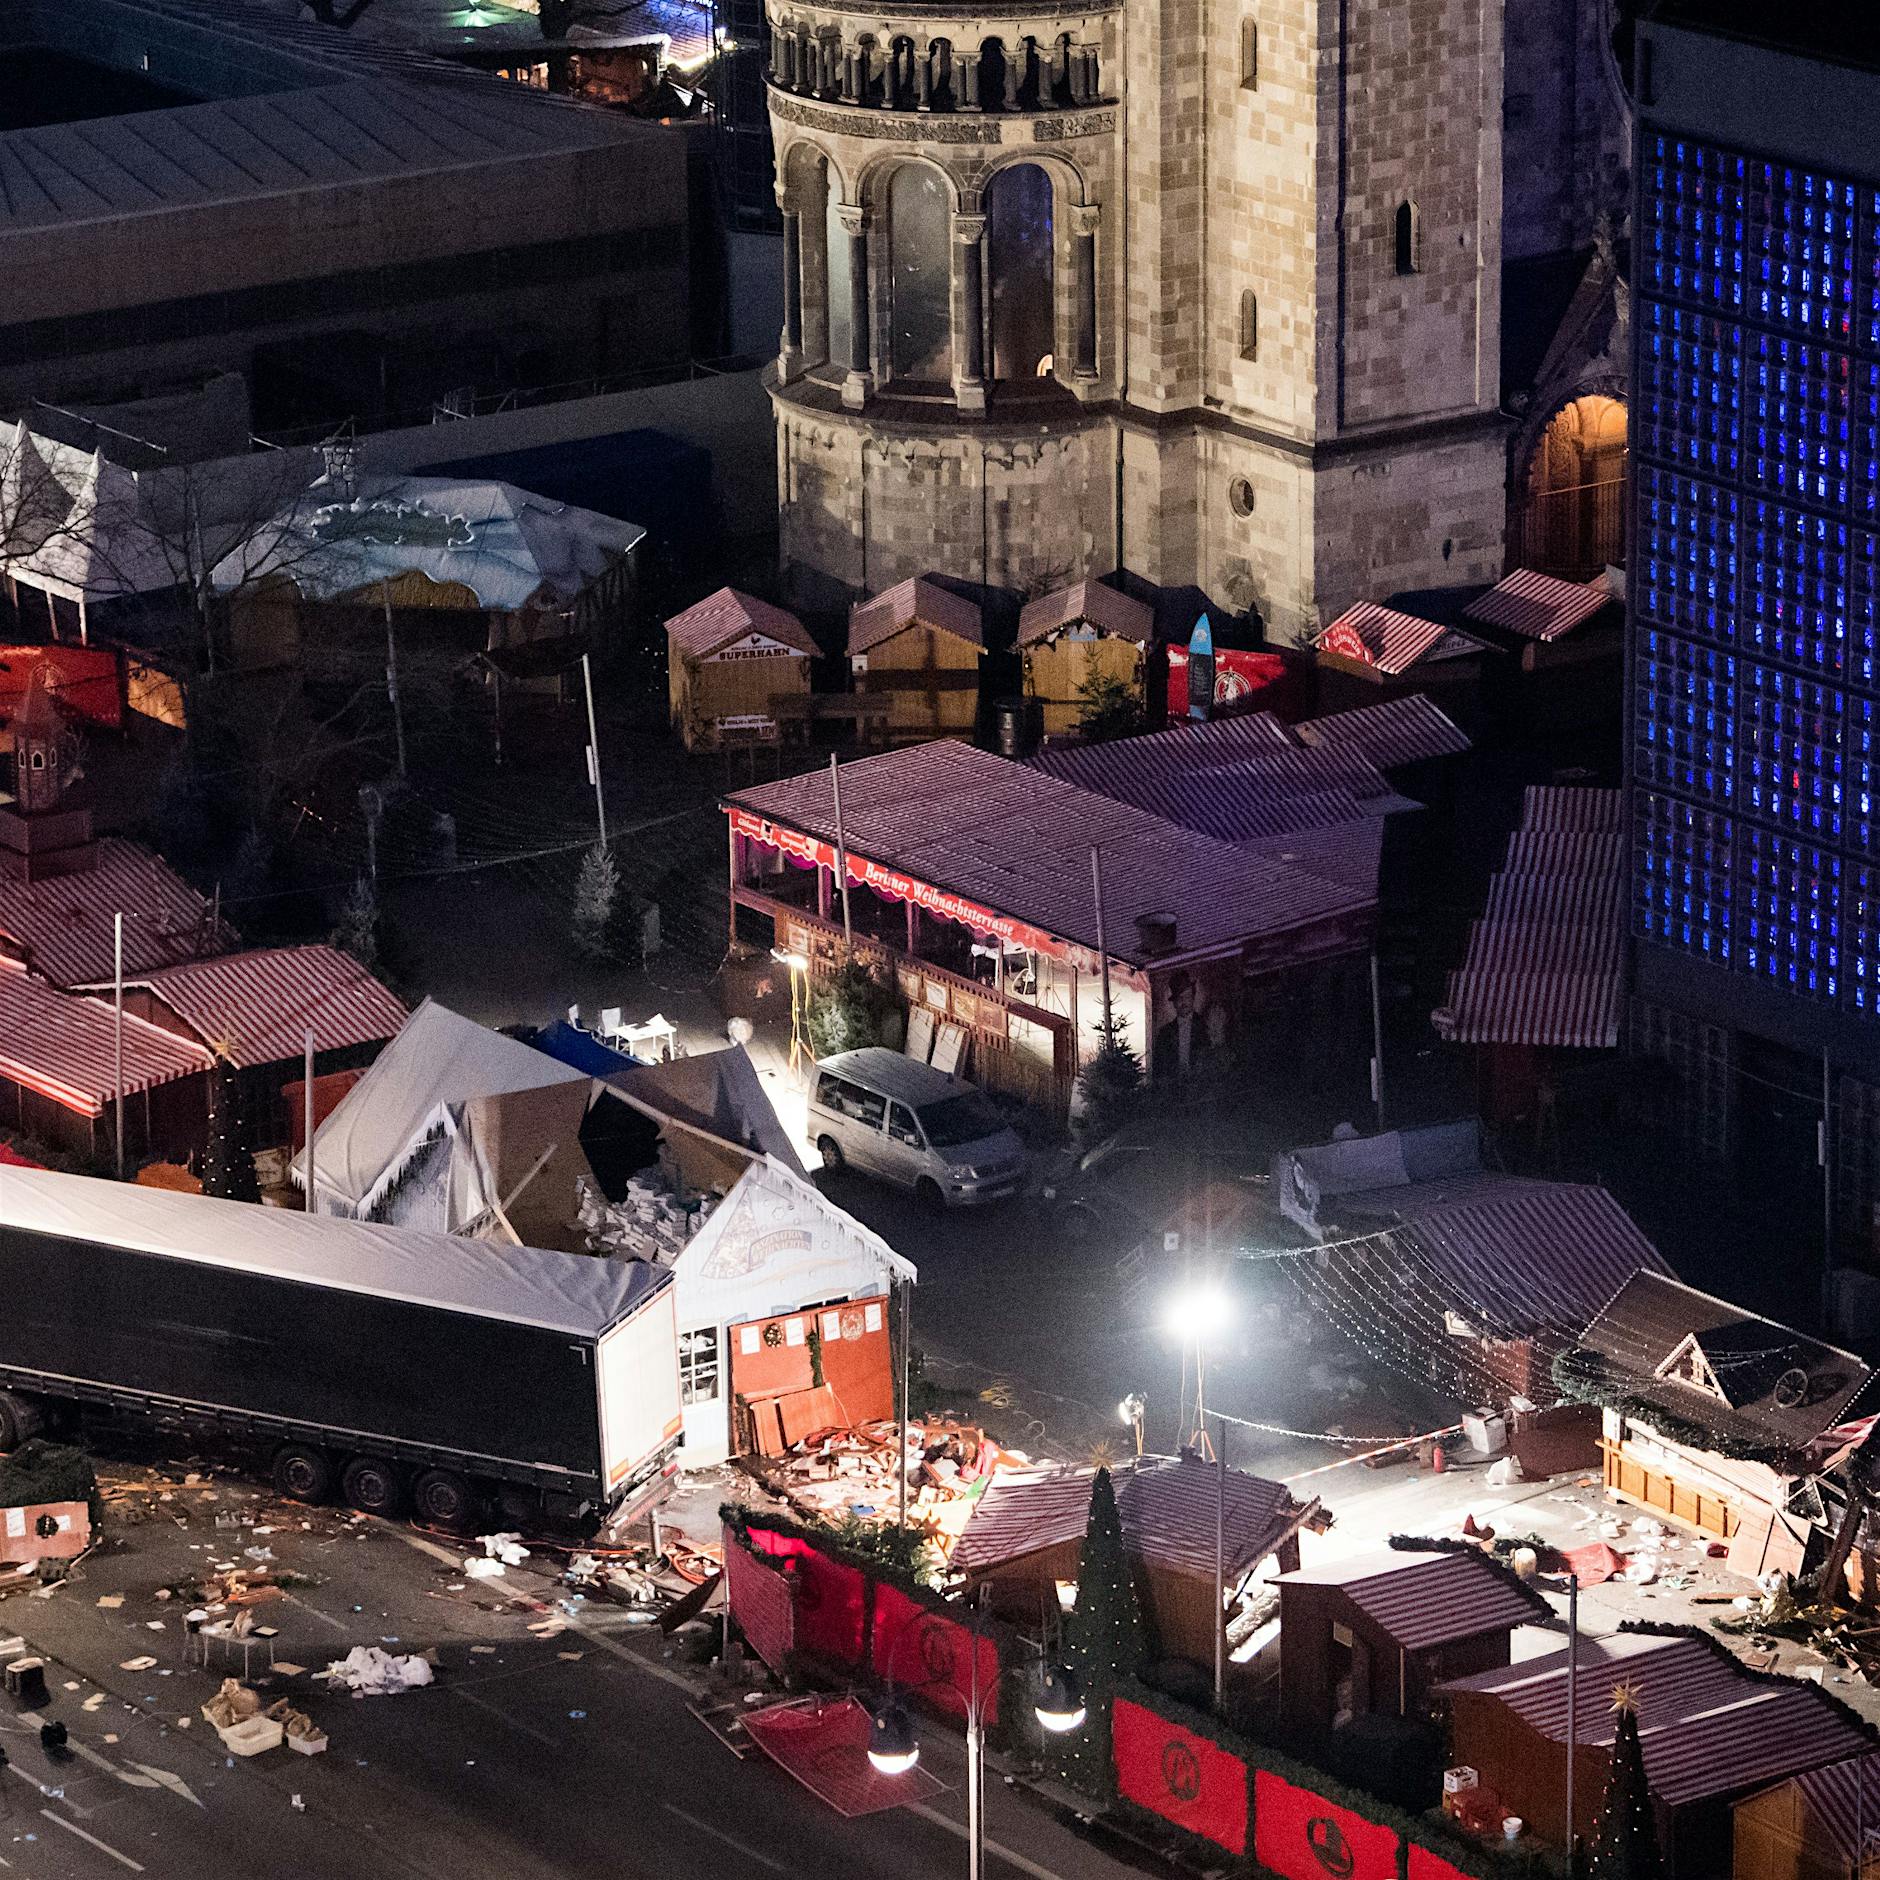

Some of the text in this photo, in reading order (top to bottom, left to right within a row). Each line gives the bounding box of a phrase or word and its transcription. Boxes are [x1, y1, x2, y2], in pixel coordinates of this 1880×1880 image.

[719, 647, 790, 661] SUPERHAHN
[865, 862, 1014, 937] Berliner Weihnachtsterrasse
